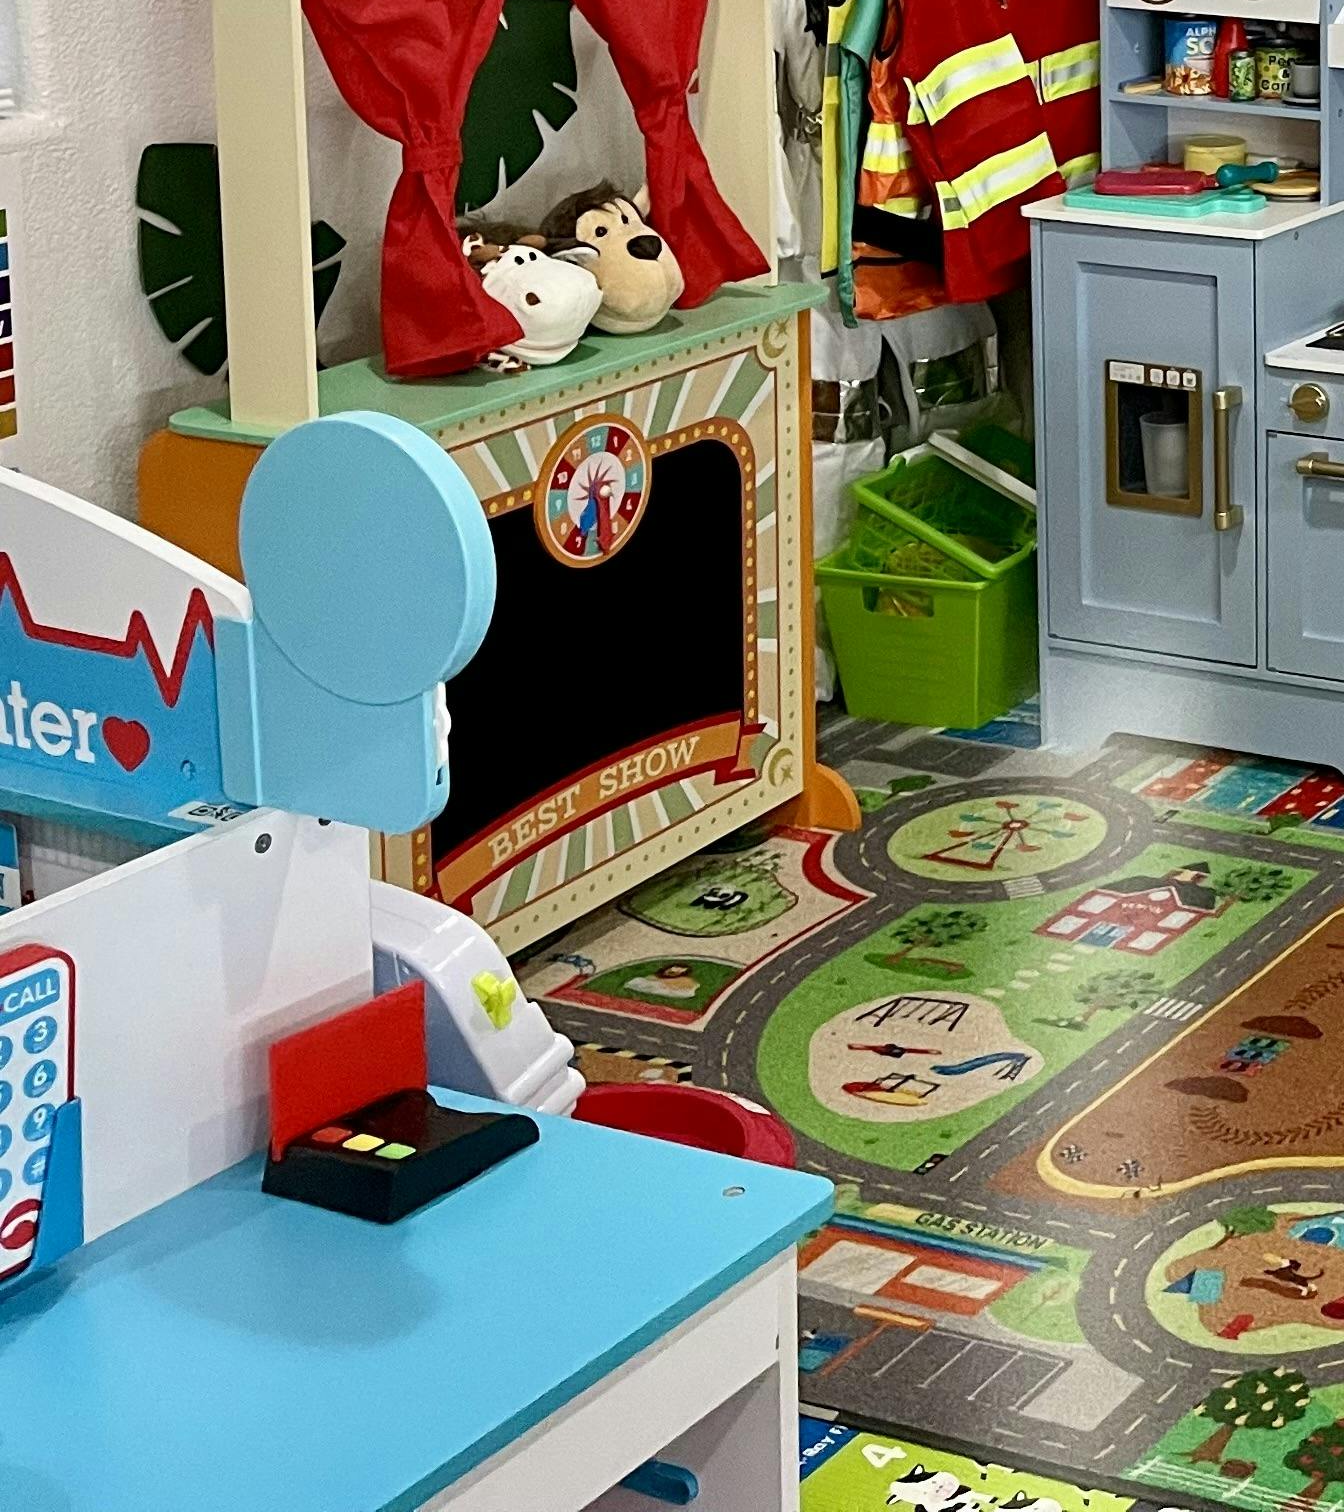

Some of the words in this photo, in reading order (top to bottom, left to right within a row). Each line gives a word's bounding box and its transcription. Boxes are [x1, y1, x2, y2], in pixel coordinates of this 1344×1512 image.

[487, 784, 581, 868] BEST
[598, 735, 700, 800] SHOW
[4, 976, 57, 1015] CALL
[32, 1020, 48, 1042] 3
[32, 1064, 47, 1087] 6
[32, 1108, 46, 1131] 9
[916, 1213, 961, 1232] GAS
[965, 1221, 1048, 1250] STATION
[861, 1443, 907, 1468] 4
